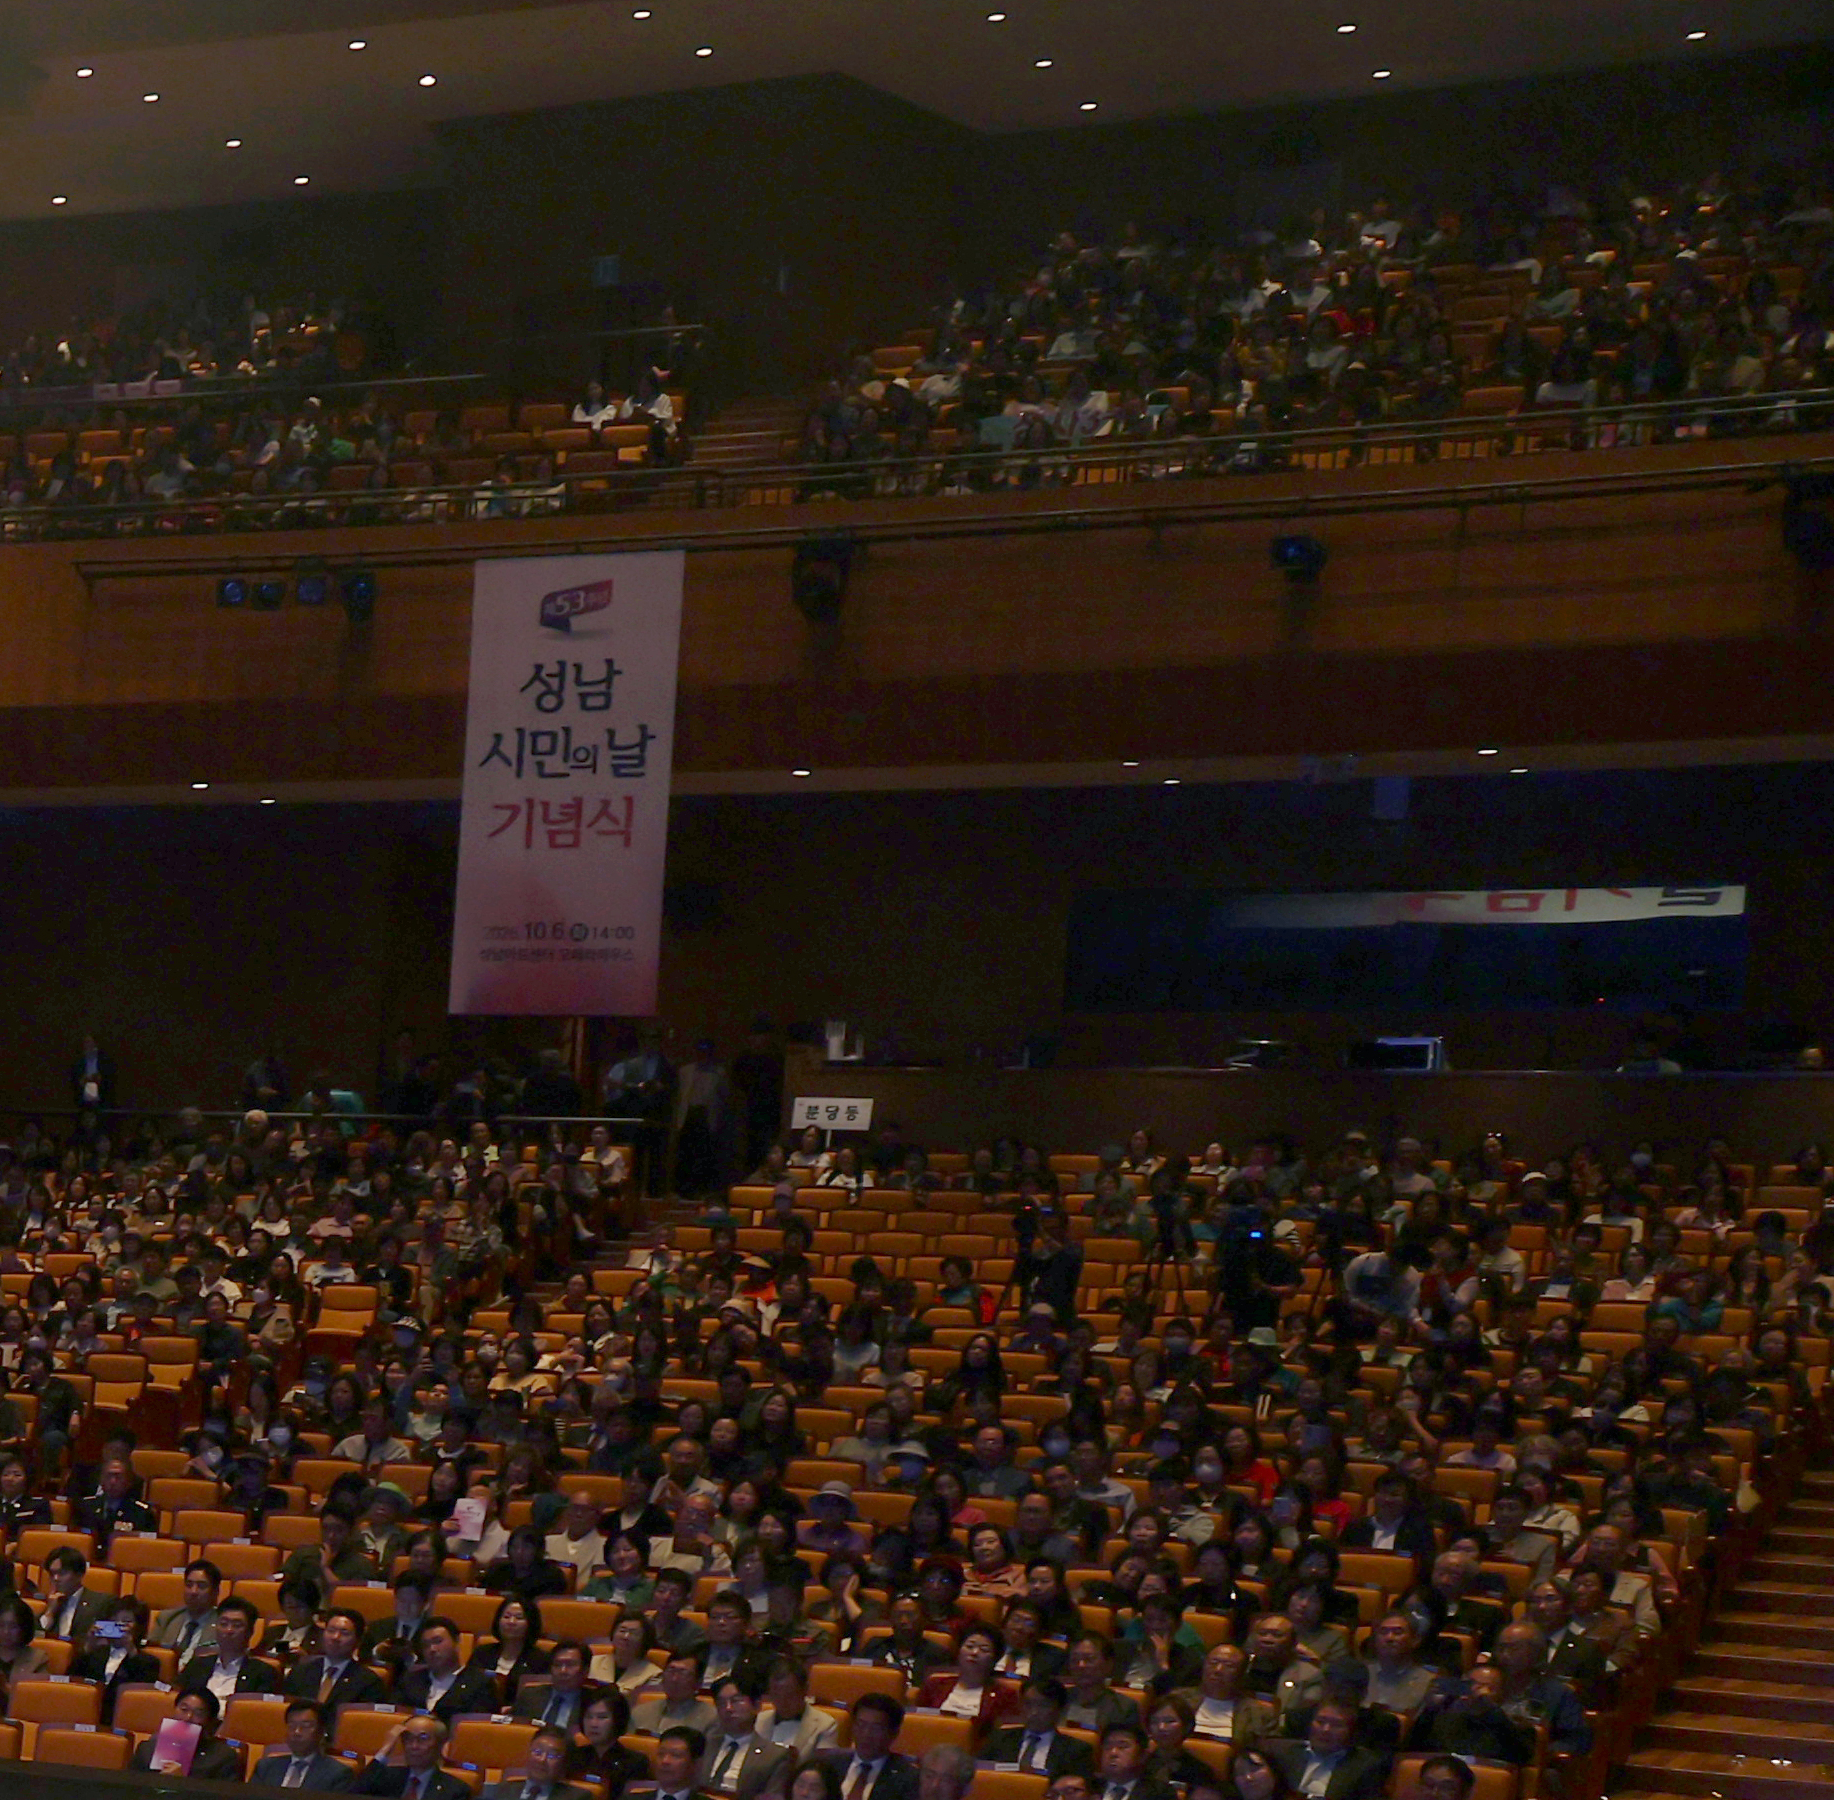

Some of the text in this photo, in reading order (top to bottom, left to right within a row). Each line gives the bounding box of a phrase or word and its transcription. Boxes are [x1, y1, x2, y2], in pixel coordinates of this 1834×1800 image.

[519, 657, 623, 713] 성남
[478, 723, 657, 779] 시민의 날
[487, 795, 634, 849] 기념식
